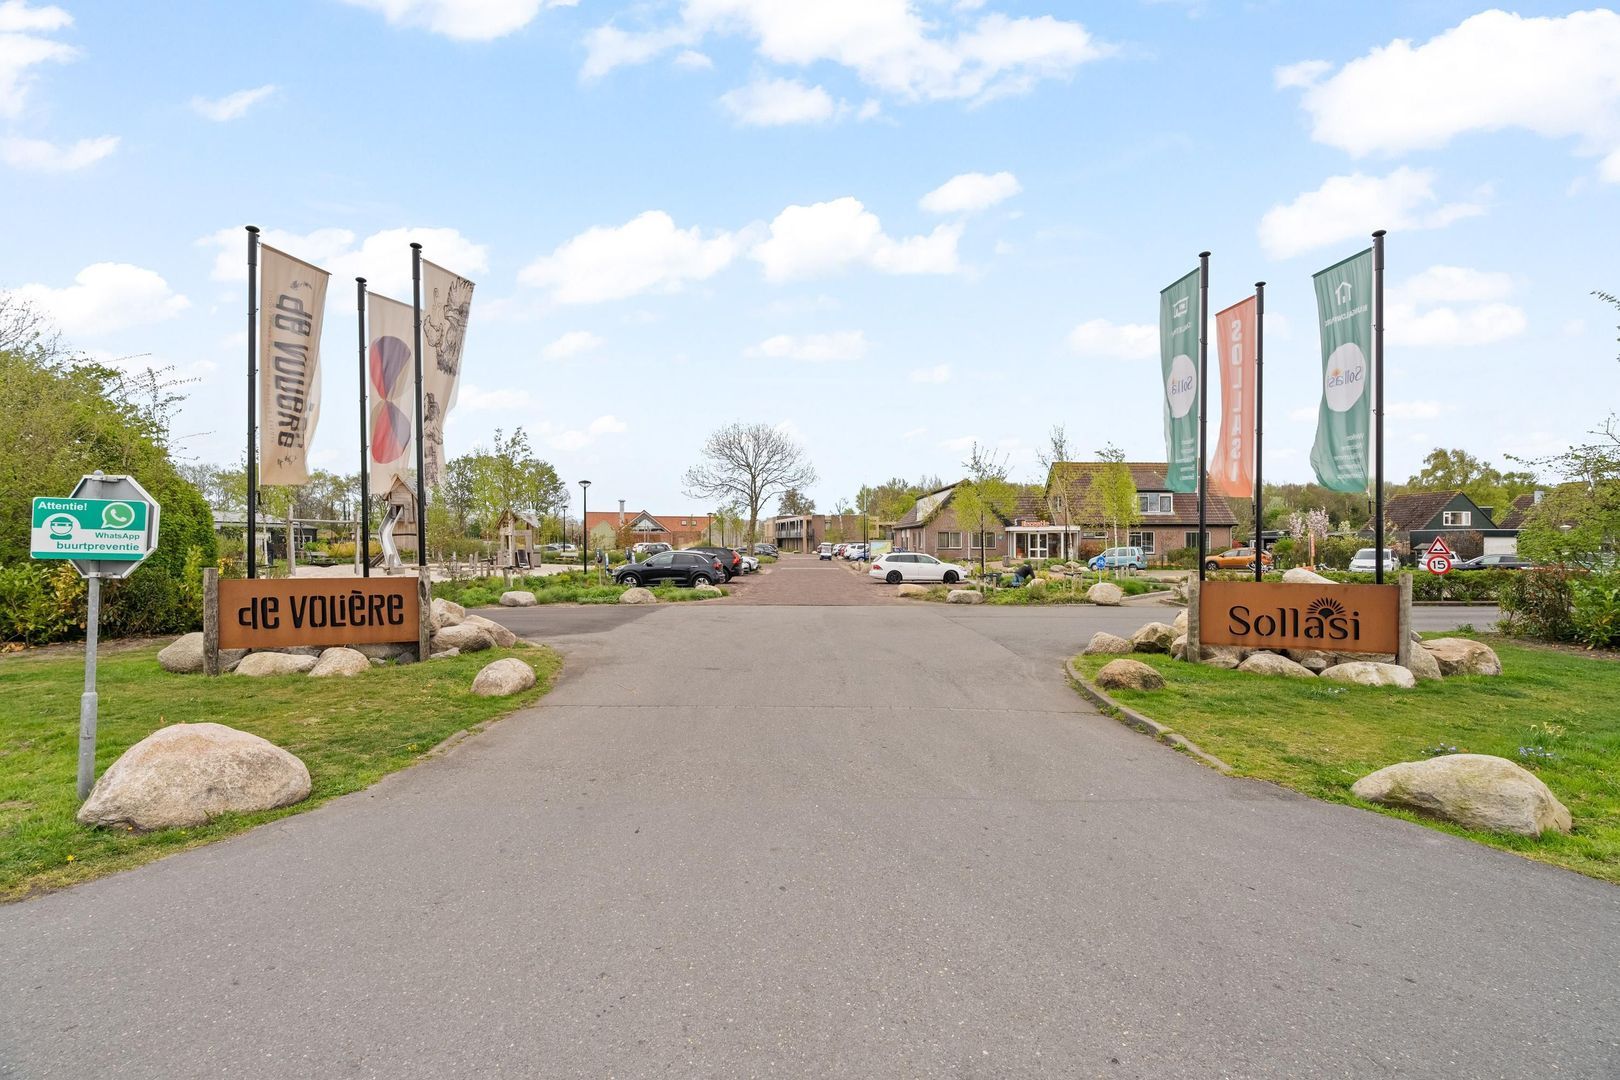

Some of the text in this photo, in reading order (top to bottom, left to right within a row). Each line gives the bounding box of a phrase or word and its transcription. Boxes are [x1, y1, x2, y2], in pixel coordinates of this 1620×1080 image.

[38, 502, 87, 511] Attentie!
[95, 532, 140, 540] WhatsApp
[56, 541, 139, 551] buurtpreventie
[1432, 560, 1446, 570] 15
[238, 596, 280, 630] de
[1228, 605, 1360, 641] Sollasi
